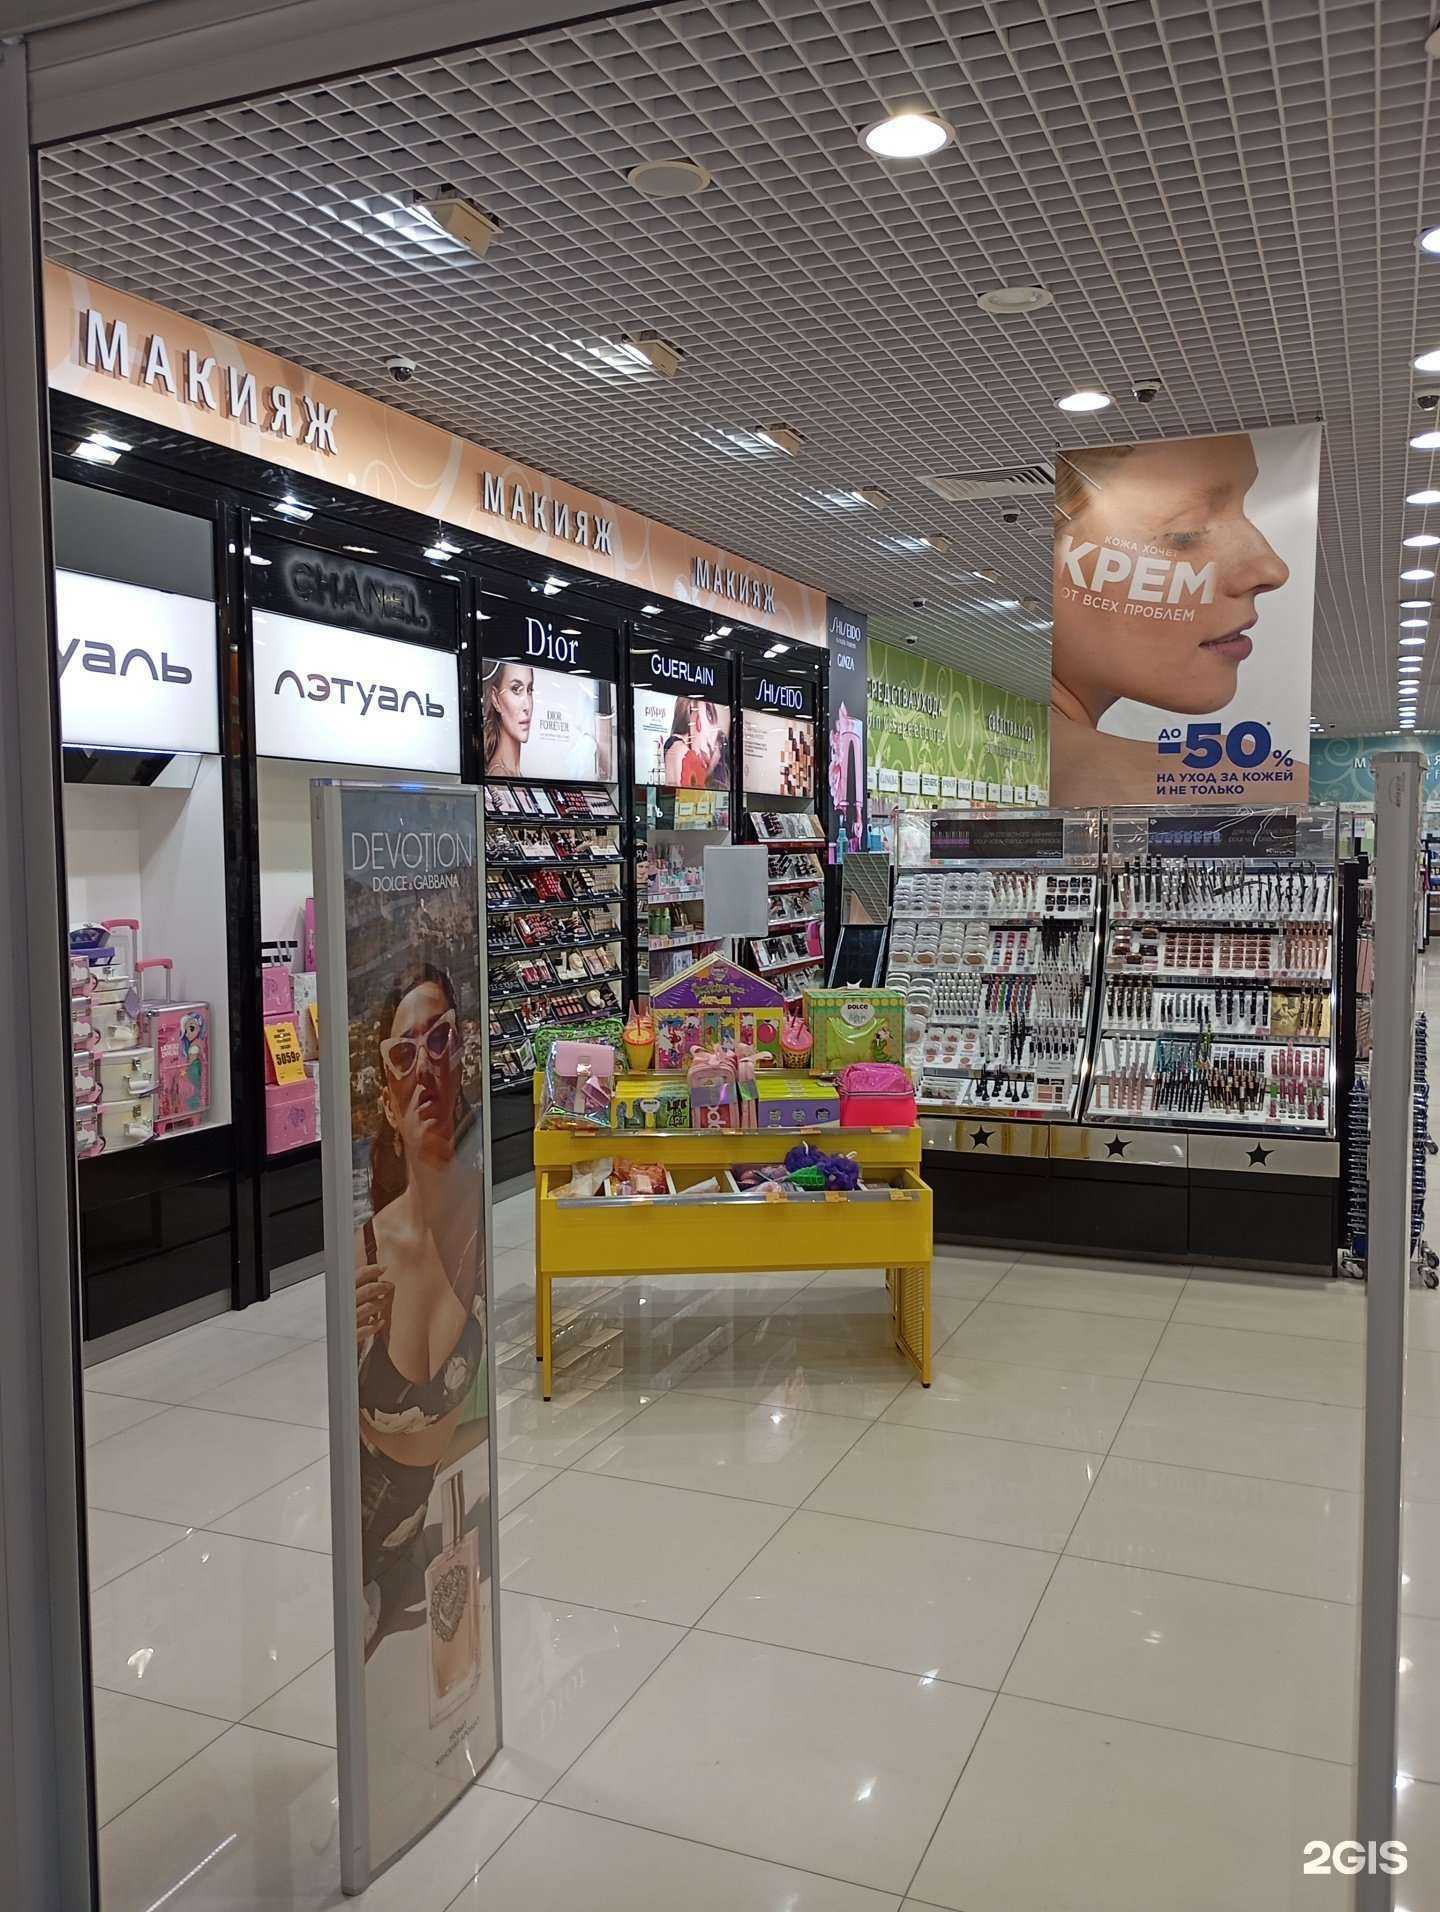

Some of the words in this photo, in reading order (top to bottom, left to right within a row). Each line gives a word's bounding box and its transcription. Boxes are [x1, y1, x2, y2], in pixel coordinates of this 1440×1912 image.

[85, 309, 338, 456] МАКИЯЖ
[483, 471, 615, 556] МАКИЯЖ
[1104, 535, 1138, 551] КОЖА
[1058, 533, 1216, 604] КРЕМ
[694, 557, 777, 614] МАКИЯЖ
[1082, 593, 1119, 612] ВСЕХ
[1123, 603, 1196, 622] ПРОБЛЕМ
[525, 616, 579, 665] Dior
[651, 654, 715, 687] GUERLAIN
[755, 679, 804, 710] SHISEIDO
[1158, 728, 1181, 741] ДО
[1156, 773, 1175, 783] НА
[1180, 773, 1217, 784] УХОД
[1220, 772, 1239, 782] ЗА
[1243, 769, 1293, 782] КОЖЕЙ
[1156, 785, 1166, 795] И
[1169, 785, 1187, 795] НЕ
[1190, 785, 1244, 795] ТОЛЬКО
[351, 831, 472, 873] DEVOTION
